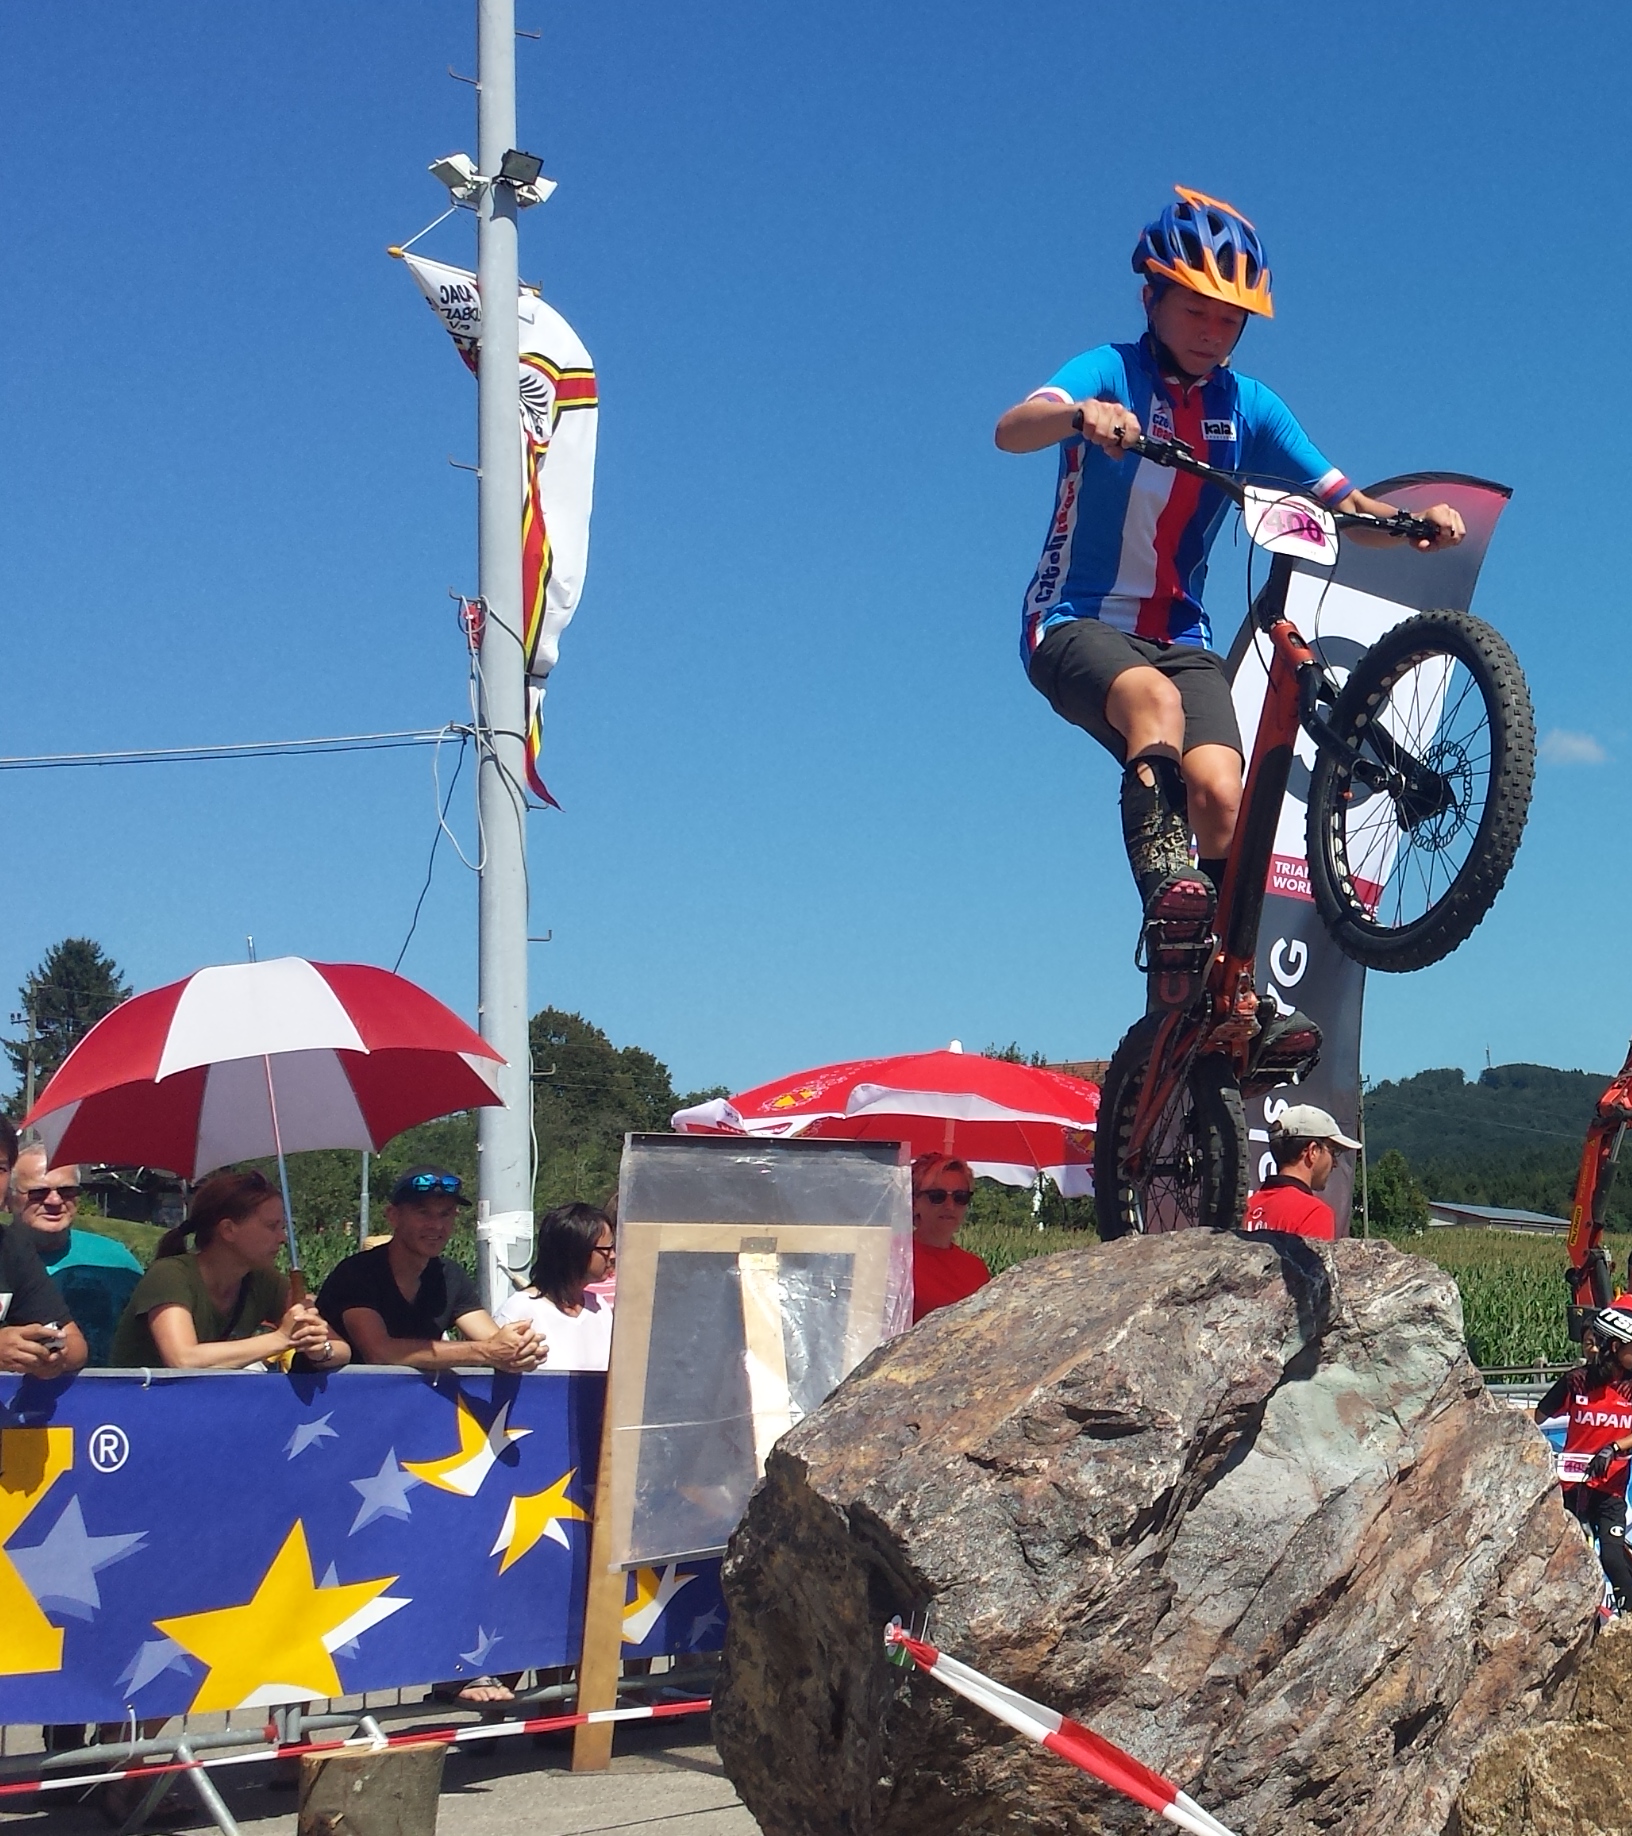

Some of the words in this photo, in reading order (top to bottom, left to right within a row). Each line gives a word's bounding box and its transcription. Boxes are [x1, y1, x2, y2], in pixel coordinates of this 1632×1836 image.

[1274, 860, 1310, 880] TRIA
[1272, 876, 1313, 895] WORL
[1574, 1410, 1632, 1429] JAPAN
